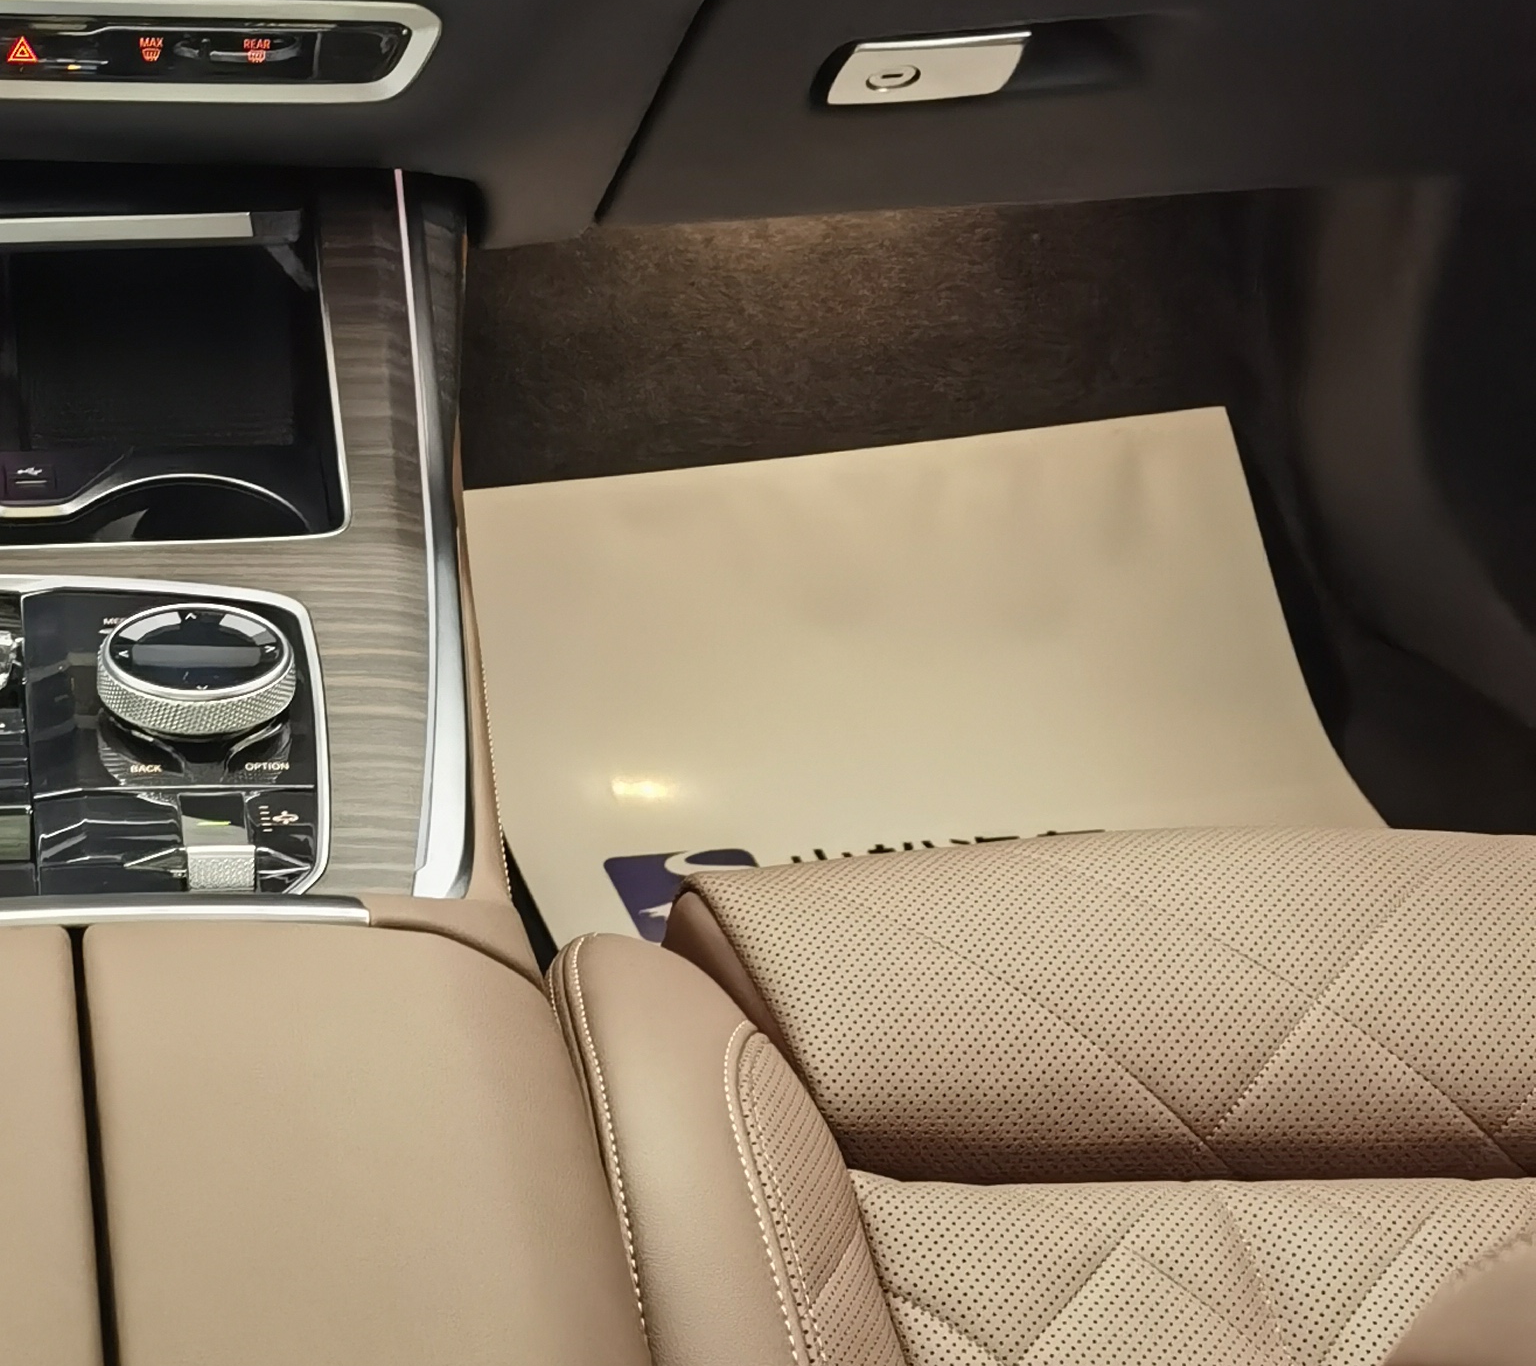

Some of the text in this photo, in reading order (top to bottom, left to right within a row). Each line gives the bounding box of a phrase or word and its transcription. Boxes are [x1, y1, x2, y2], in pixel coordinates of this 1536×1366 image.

[139, 37, 164, 48] MAX
[243, 38, 272, 50] REAR
[129, 763, 163, 774] BACK
[244, 762, 291, 772] OPTION
